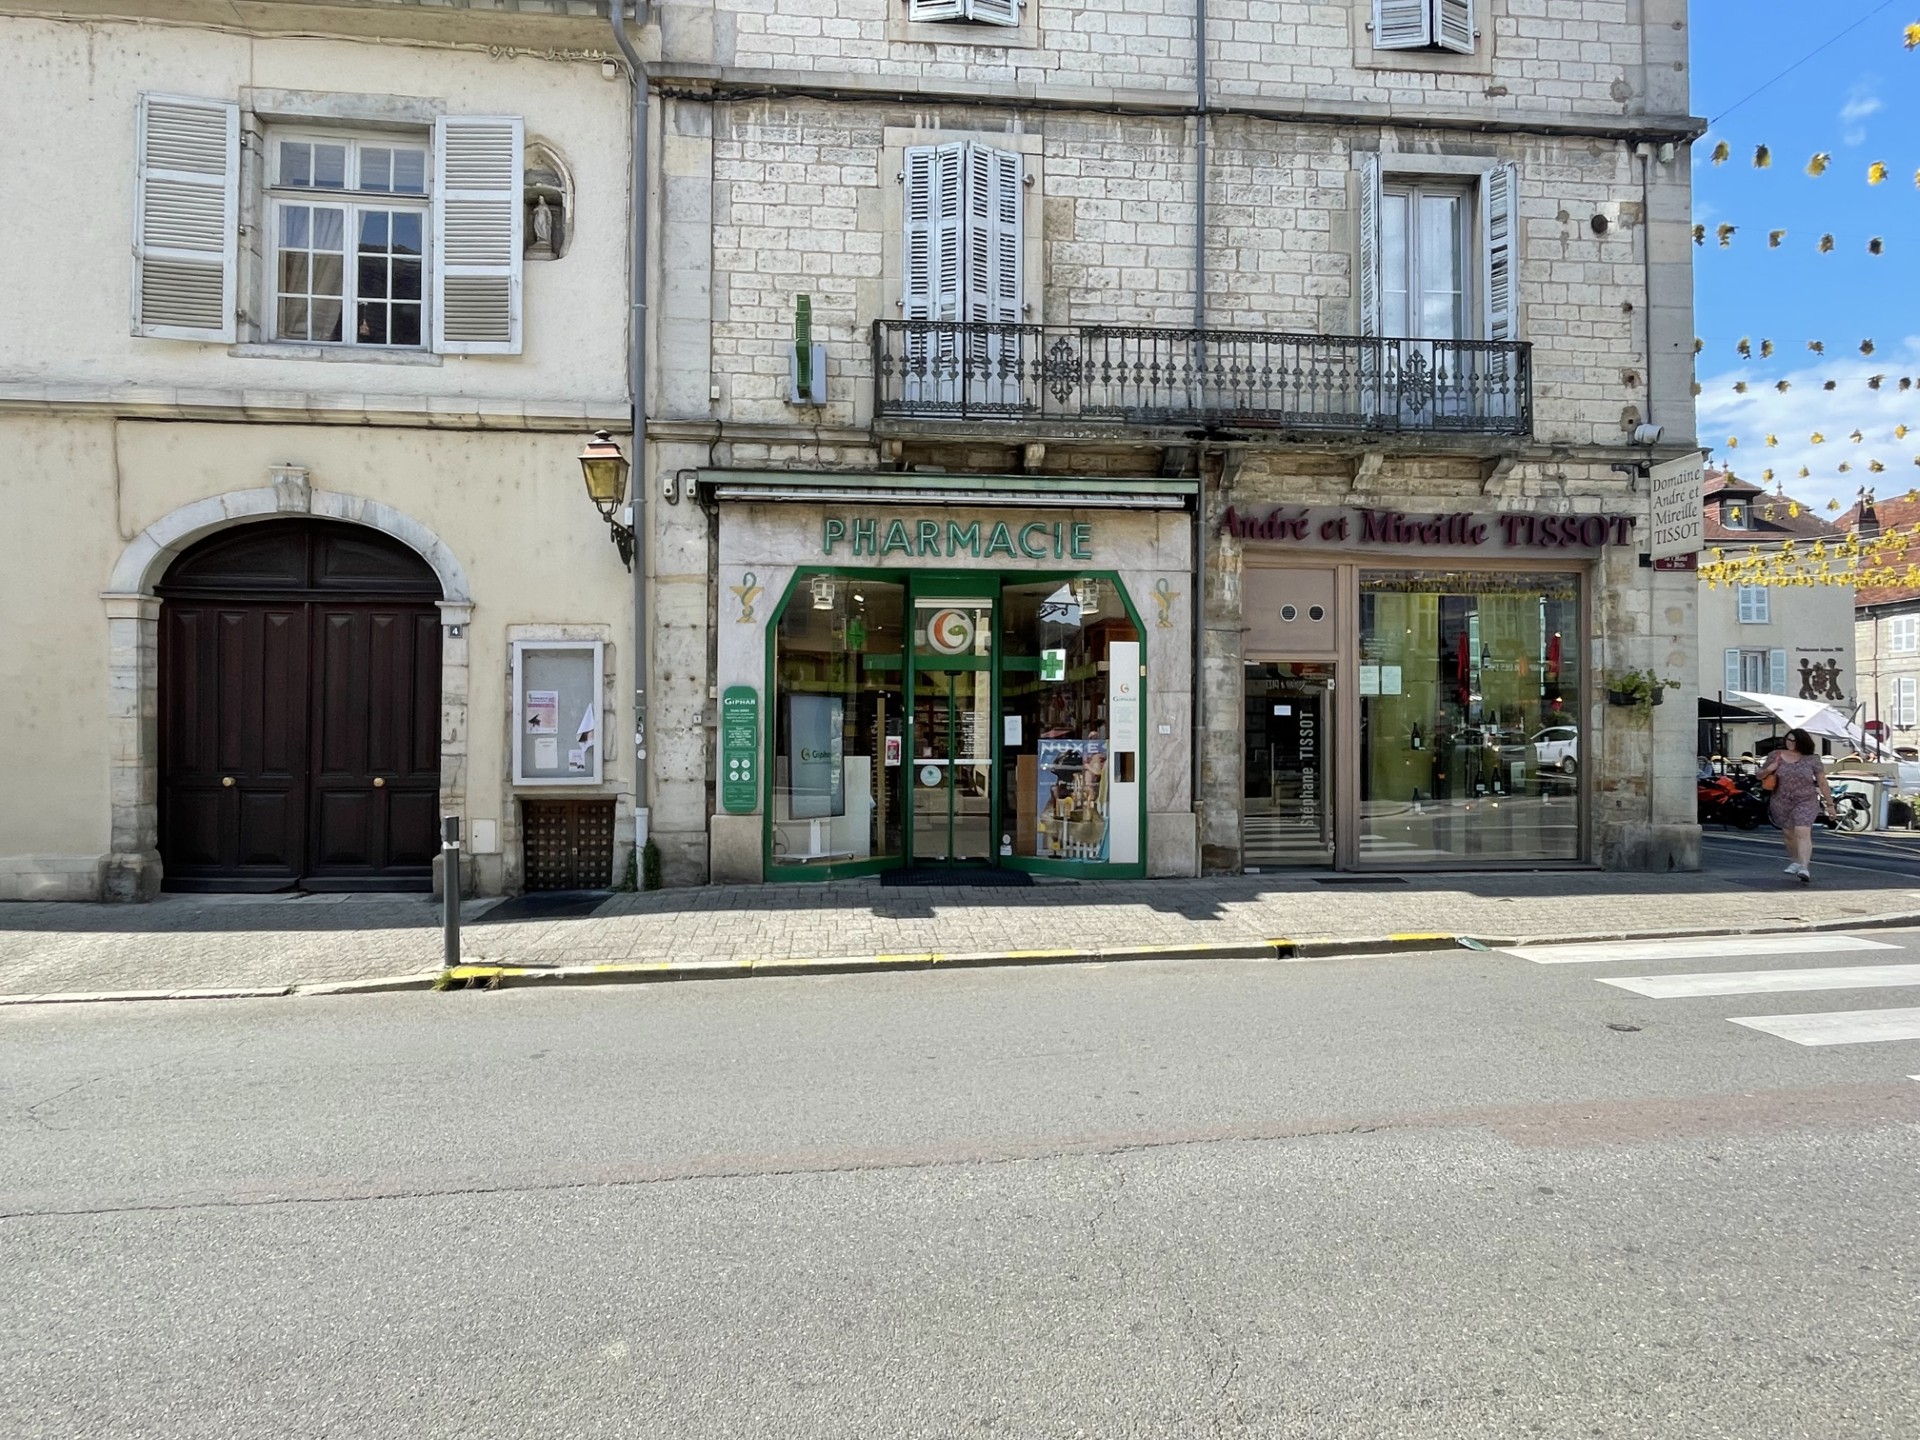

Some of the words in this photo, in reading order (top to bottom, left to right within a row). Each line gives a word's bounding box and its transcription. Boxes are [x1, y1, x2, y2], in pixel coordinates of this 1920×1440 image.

[1653, 468, 1700, 492] Domaine
[1653, 487, 1686, 509] André
[1688, 485, 1699, 500] et
[1217, 505, 1310, 541] André
[1320, 514, 1350, 541] et
[1359, 508, 1490, 545] Mireille
[1499, 513, 1636, 547] TISSOT
[1656, 502, 1698, 526] Mireille
[822, 518, 1092, 559] PHARMACIE
[1655, 522, 1700, 545] TISSOT
[452, 627, 459, 635] 4
[1041, 742, 1099, 753] NUXE
[1300, 711, 1314, 760] TISSOT
[1300, 767, 1317, 827] Stéphane
